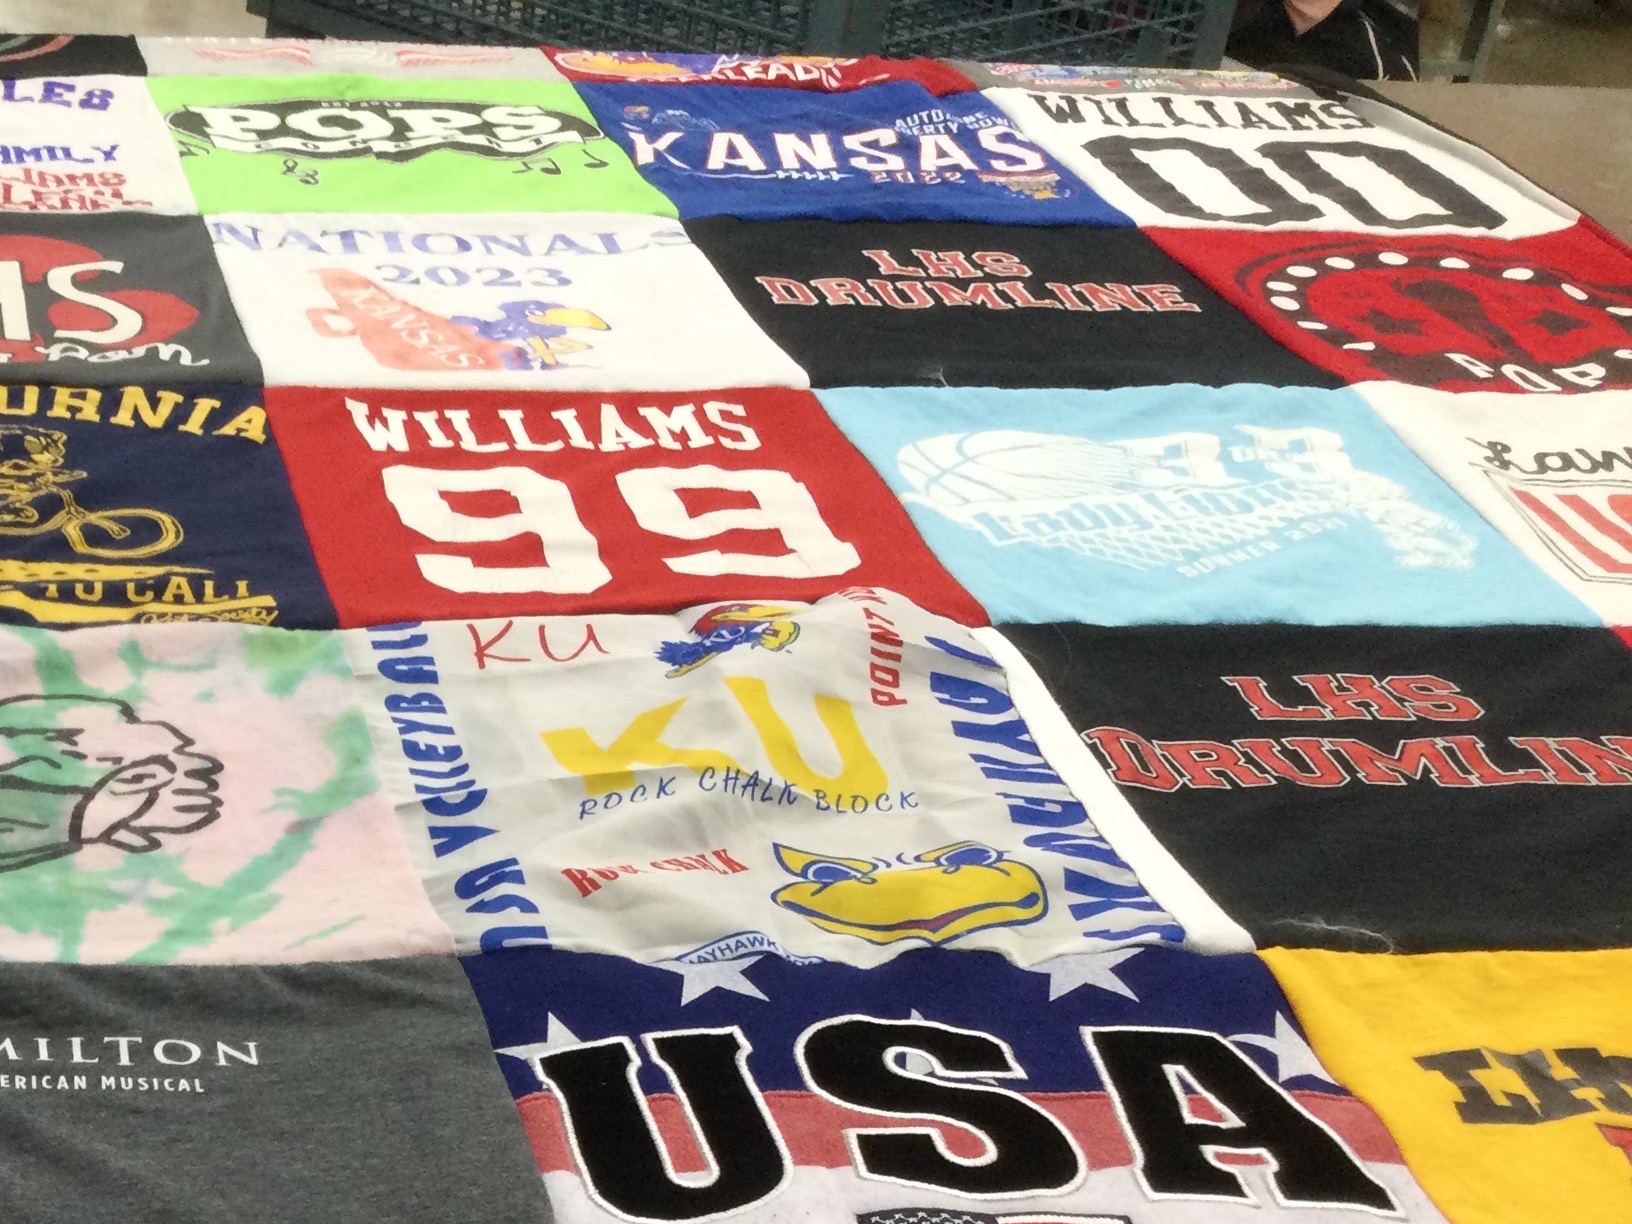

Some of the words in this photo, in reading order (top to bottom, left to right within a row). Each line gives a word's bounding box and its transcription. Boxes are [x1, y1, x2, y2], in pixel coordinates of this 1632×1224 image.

[185, 103, 563, 143] POPS
[1027, 92, 1374, 131] WILLIAMS
[624, 125, 1050, 173] KANSAS
[1081, 134, 1508, 230] 00
[373, 263, 573, 288] 2023
[862, 248, 1033, 279] LHS
[755, 275, 1203, 313] DRUMLINE
[340, 286, 488, 370] KANSAS
[343, 396, 763, 453] WILLIAMS
[381, 463, 862, 595] 99
[126, 575, 252, 603] CALI
[465, 619, 612, 669] KU
[1220, 673, 1486, 722] LHS
[538, 675, 890, 802] KU
[578, 776, 677, 821] ROCK
[697, 765, 799, 807] CHALK
[812, 787, 920, 815] BLOCK
[100, 1074, 206, 1094] MUSICAL
